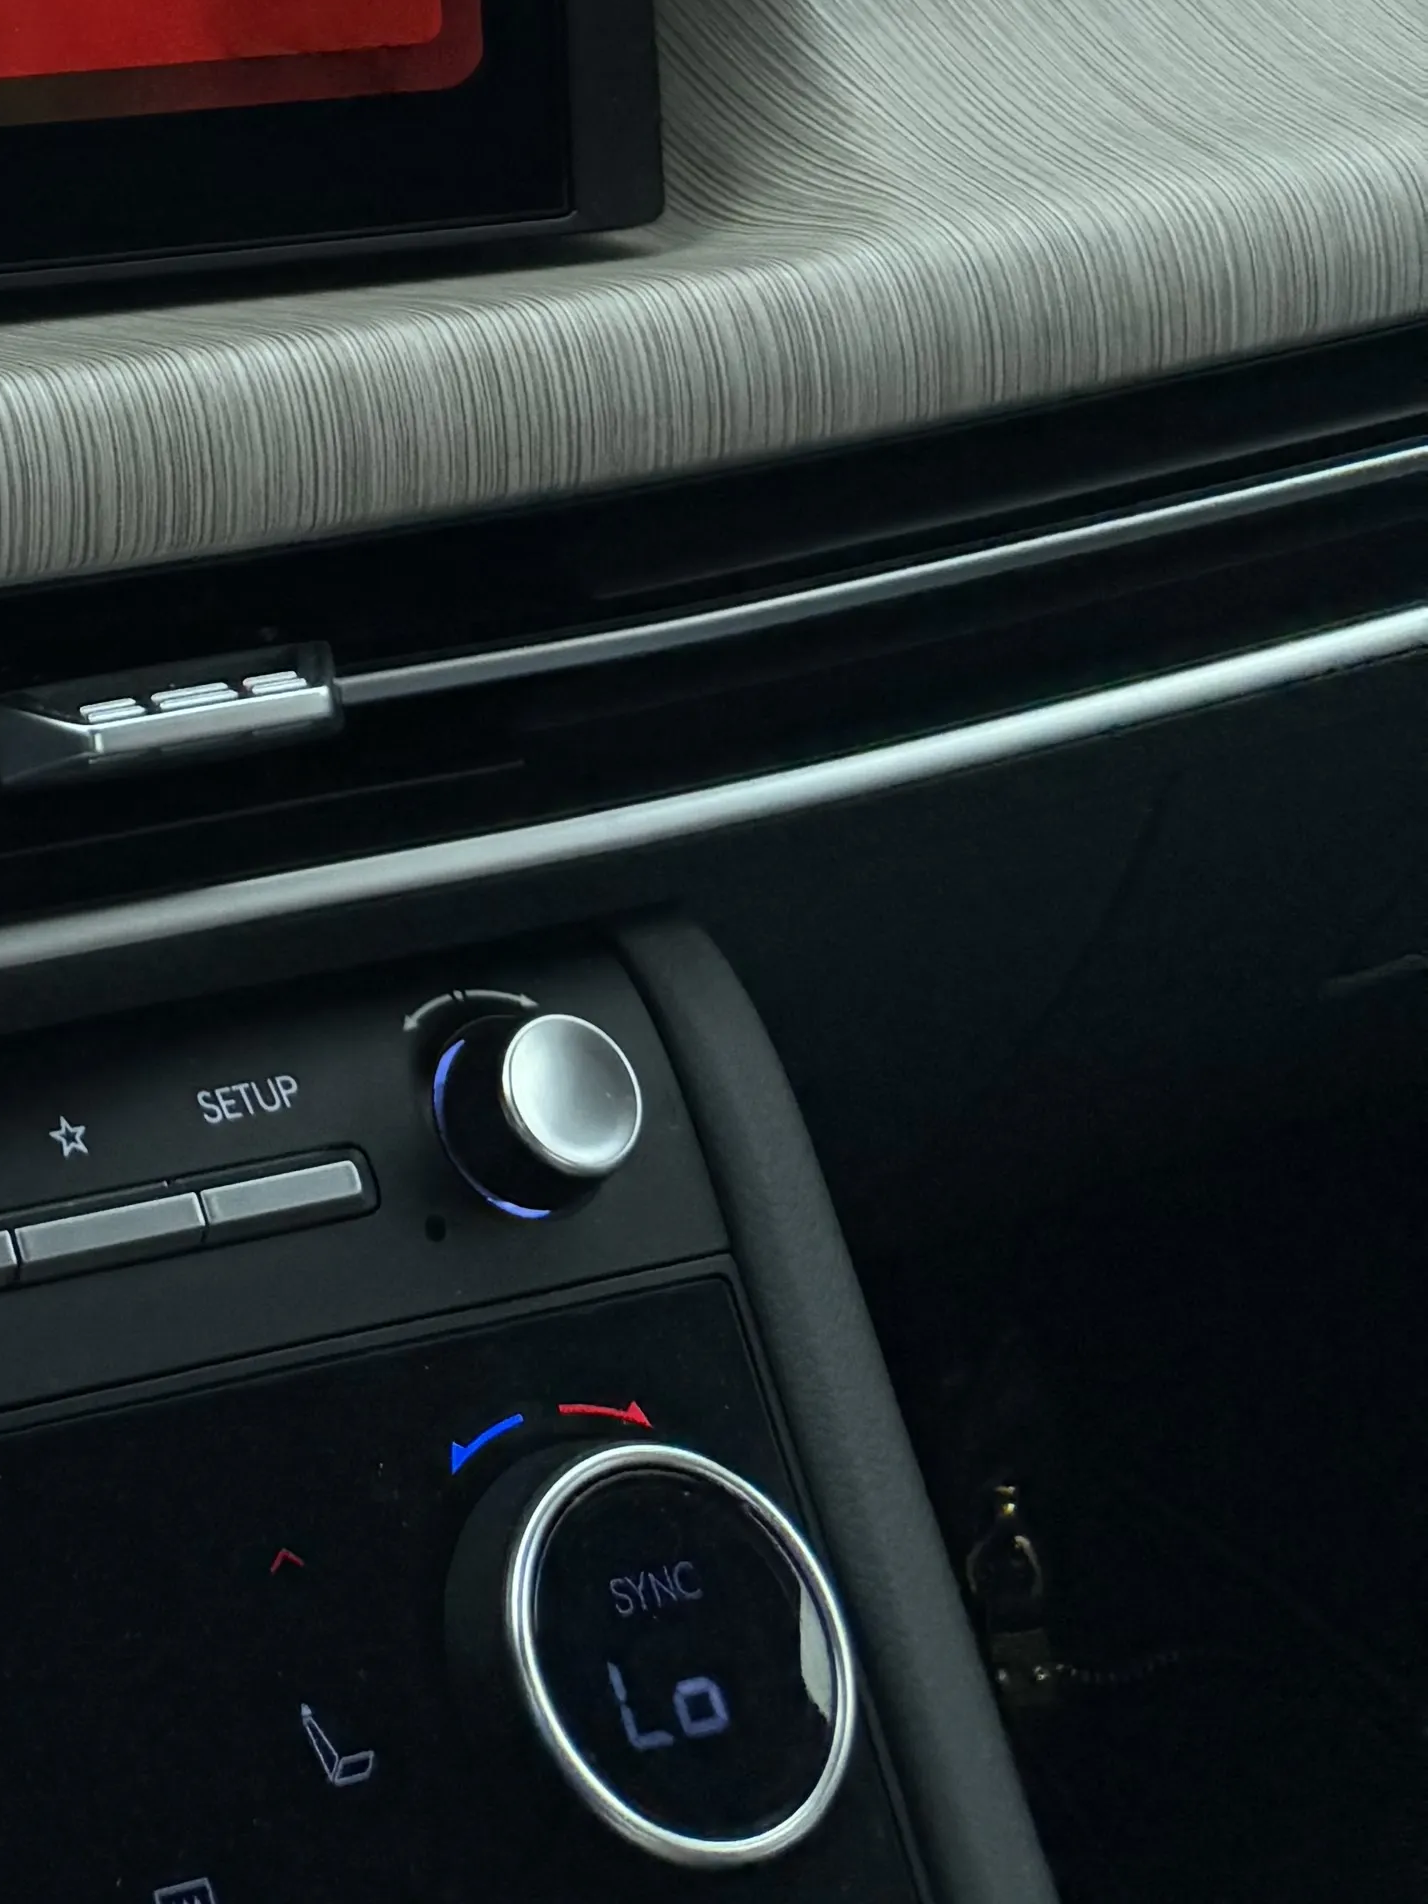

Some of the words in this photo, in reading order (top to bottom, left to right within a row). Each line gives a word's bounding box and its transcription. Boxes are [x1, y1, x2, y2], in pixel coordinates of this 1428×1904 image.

[196, 1075, 298, 1124] SETUP
[609, 1561, 702, 1615] SYNC
[607, 1662, 729, 1750] Lo
